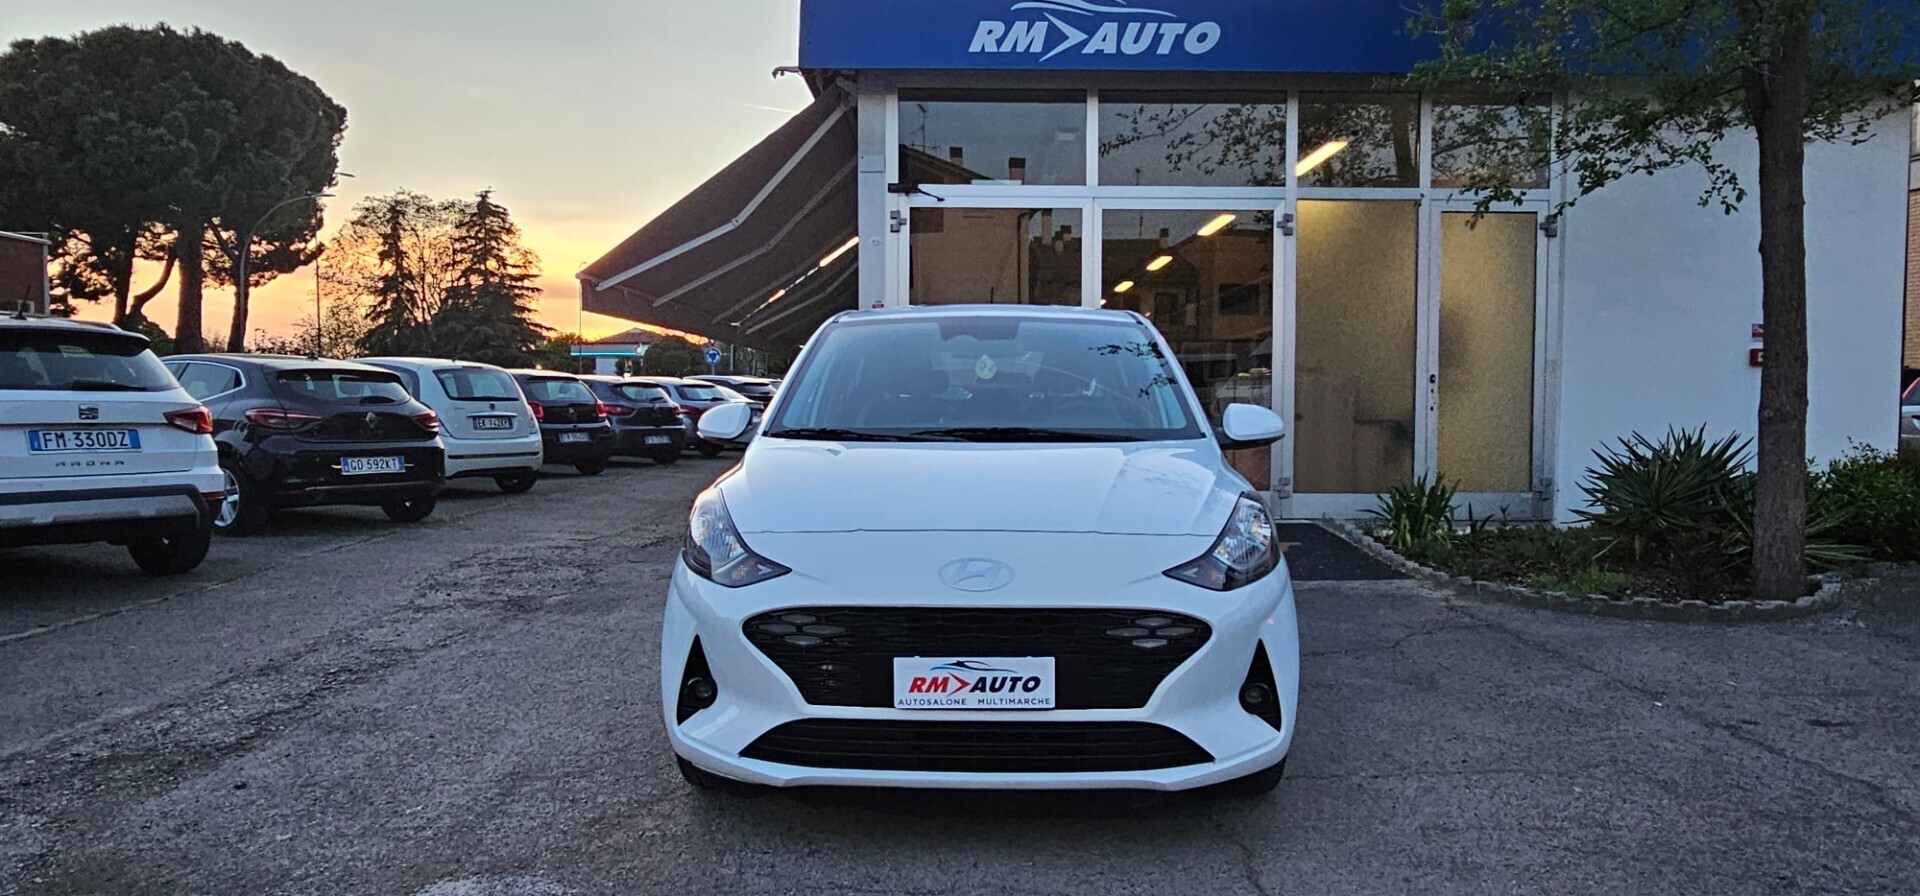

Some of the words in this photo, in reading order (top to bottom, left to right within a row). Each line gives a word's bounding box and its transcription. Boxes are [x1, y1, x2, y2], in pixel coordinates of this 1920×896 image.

[968, 20, 1049, 53] RM
[1081, 21, 1222, 55] AUTO
[42, 431, 67, 449] FM
[366, 457, 397, 470] 592KT
[908, 676, 950, 693] RM
[969, 675, 1042, 693] AUTO
[898, 698, 967, 706] AUTOSALONE
[977, 697, 1051, 706] MULTIMARCHE
